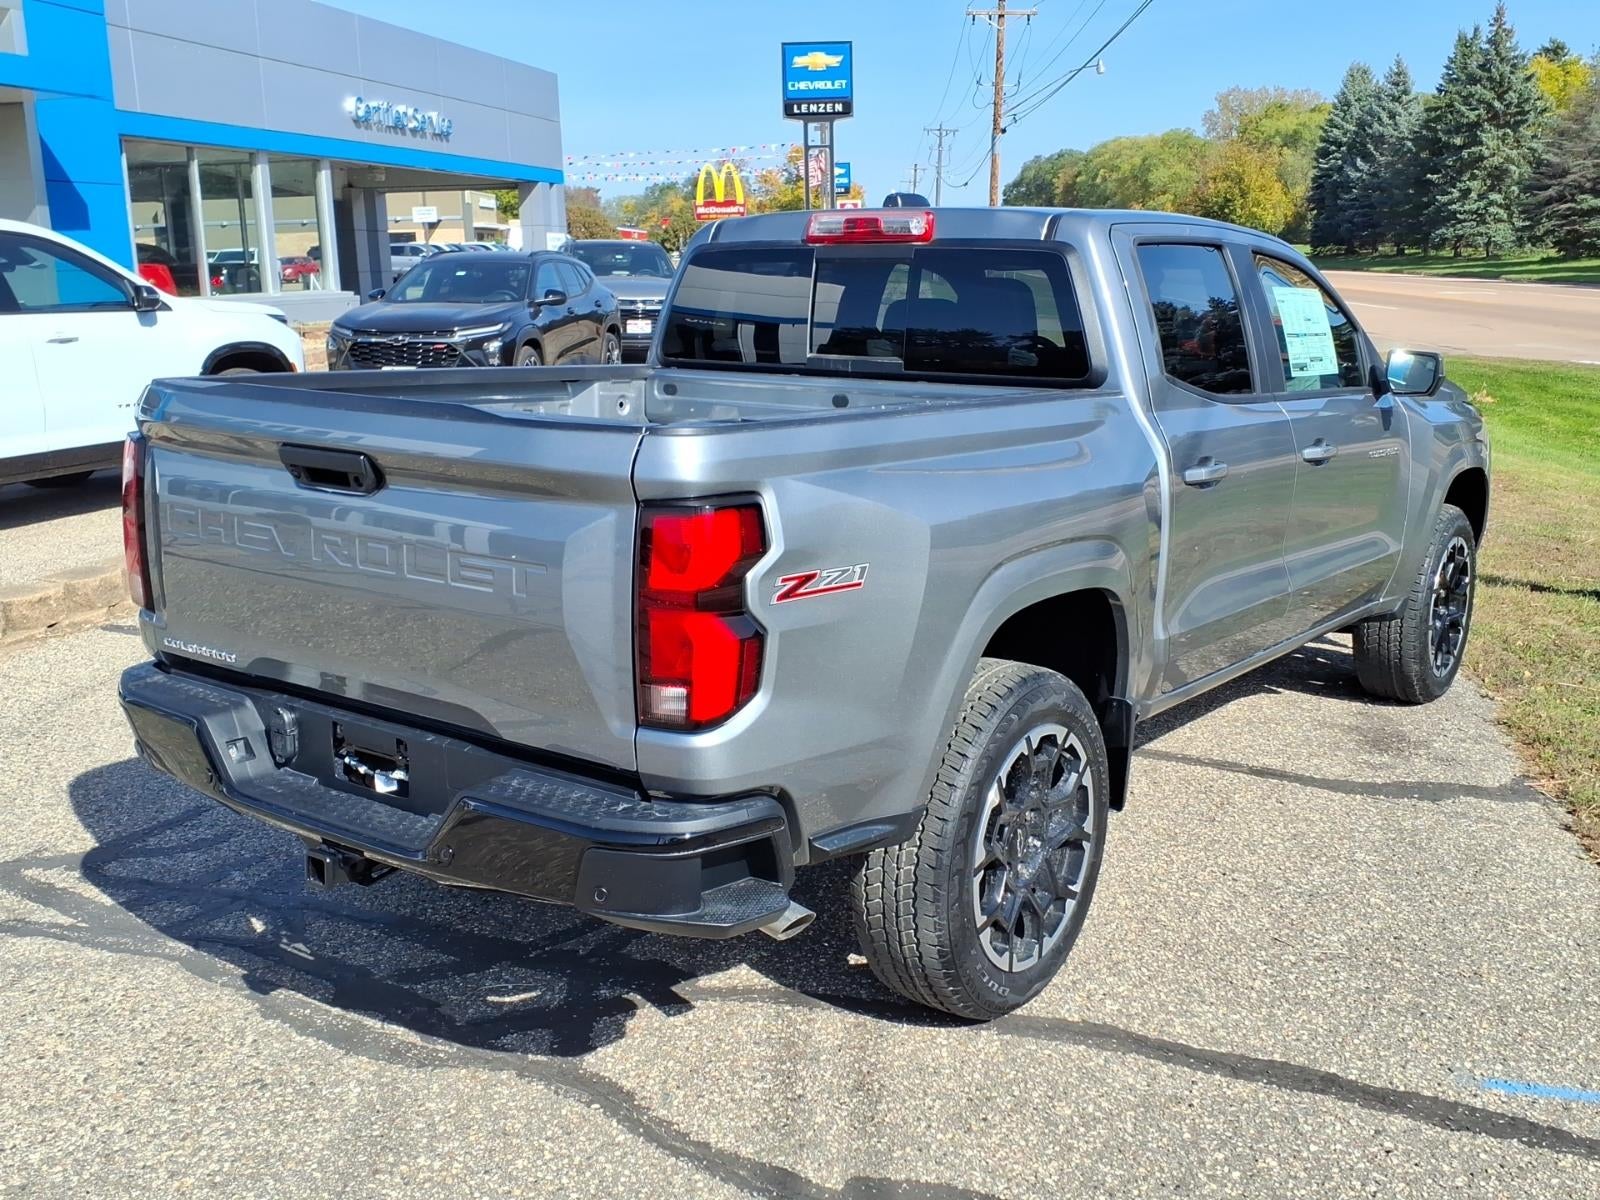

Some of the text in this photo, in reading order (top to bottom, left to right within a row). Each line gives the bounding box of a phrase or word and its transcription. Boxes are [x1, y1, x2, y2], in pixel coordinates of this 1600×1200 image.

[788, 80, 847, 90] CHEVROLET
[346, 96, 453, 137] Certified Service
[793, 103, 843, 113] LENZEN
[165, 502, 548, 600] CHEVROLET
[769, 563, 870, 605] Z71
